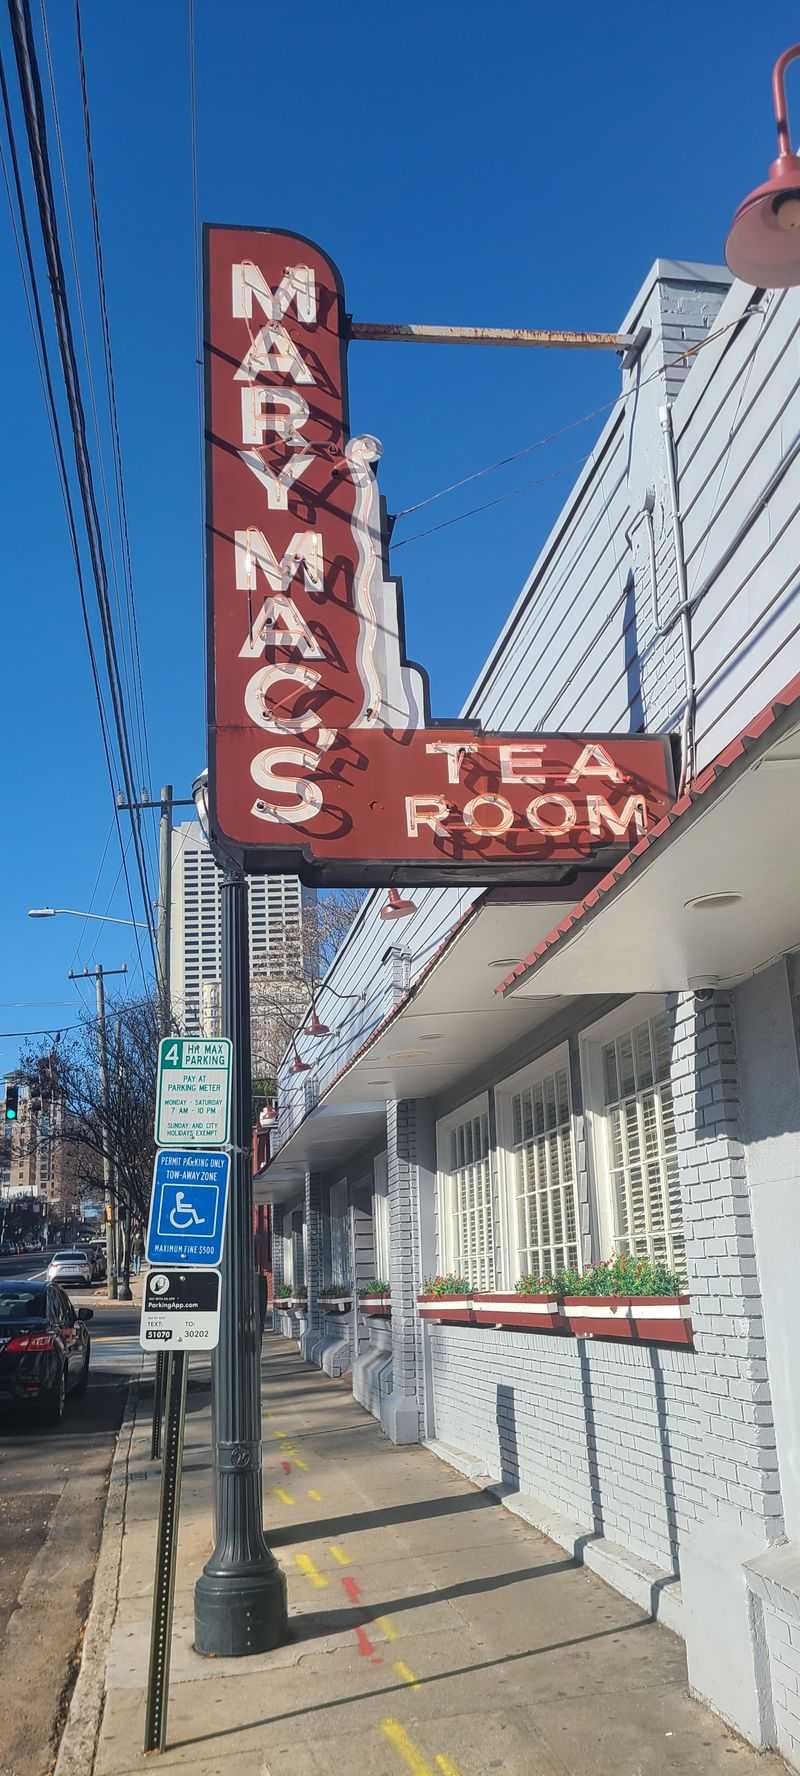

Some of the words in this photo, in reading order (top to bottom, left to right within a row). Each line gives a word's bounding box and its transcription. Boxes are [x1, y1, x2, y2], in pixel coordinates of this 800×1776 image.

[231, 260, 318, 510] MARY
[233, 527, 337, 824] MAC'S
[425, 743, 625, 784] TEA
[405, 794, 648, 838] ROOM
[165, 1043, 179, 1066] 4
[187, 1044, 200, 1054] HR
[204, 1045, 223, 1054] MAX
[185, 1055, 225, 1065] PARKING
[161, 1156, 181, 1166] PERMIT
[182, 1157, 209, 1167] PARKING
[210, 1159, 225, 1168] ONLY
[166, 1170, 200, 1180] TOW-AWAY
[200, 1171, 217, 1181] ZONE
[154, 1244, 183, 1253] MAXIMUM
[148, 1302, 199, 1310] ParkingApp.com
